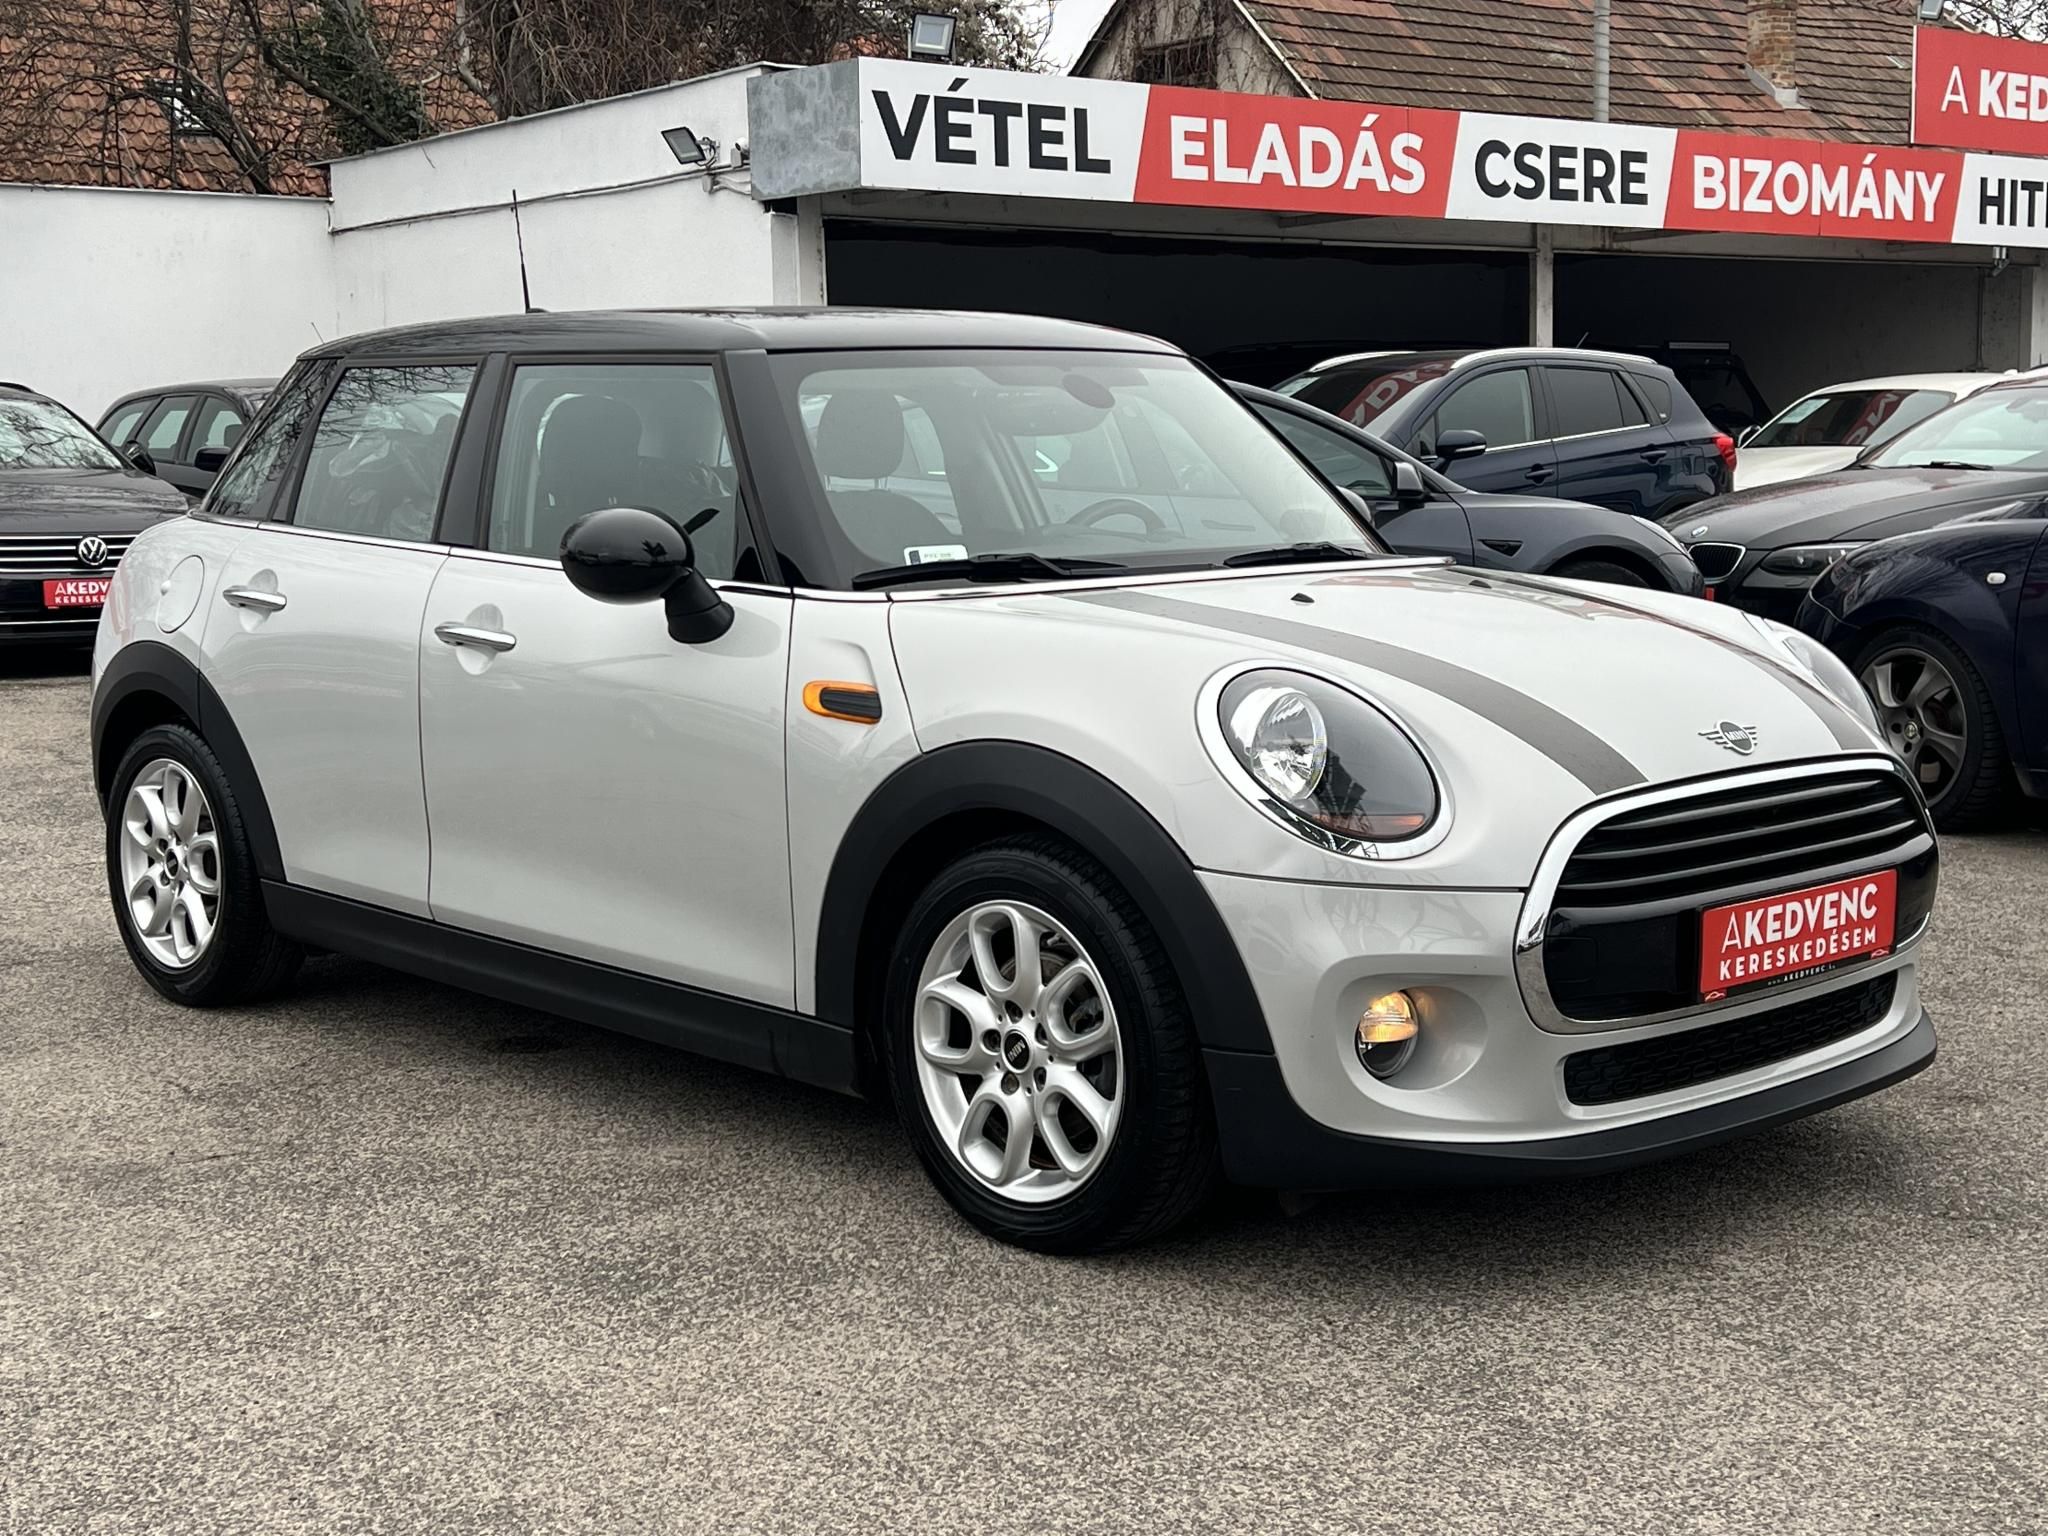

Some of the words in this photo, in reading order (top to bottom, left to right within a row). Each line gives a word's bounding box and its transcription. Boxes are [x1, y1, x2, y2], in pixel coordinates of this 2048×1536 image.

[1940, 65, 1969, 115] A
[871, 78, 1111, 174] VÉTEL
[1170, 113, 1426, 194] ELADÁS
[1474, 139, 1649, 205] CSERE
[1693, 153, 1946, 222] BIZOMÁNY
[1979, 176, 2048, 228] HIT
[1719, 926, 1876, 981] KERESKEDÉSEM
